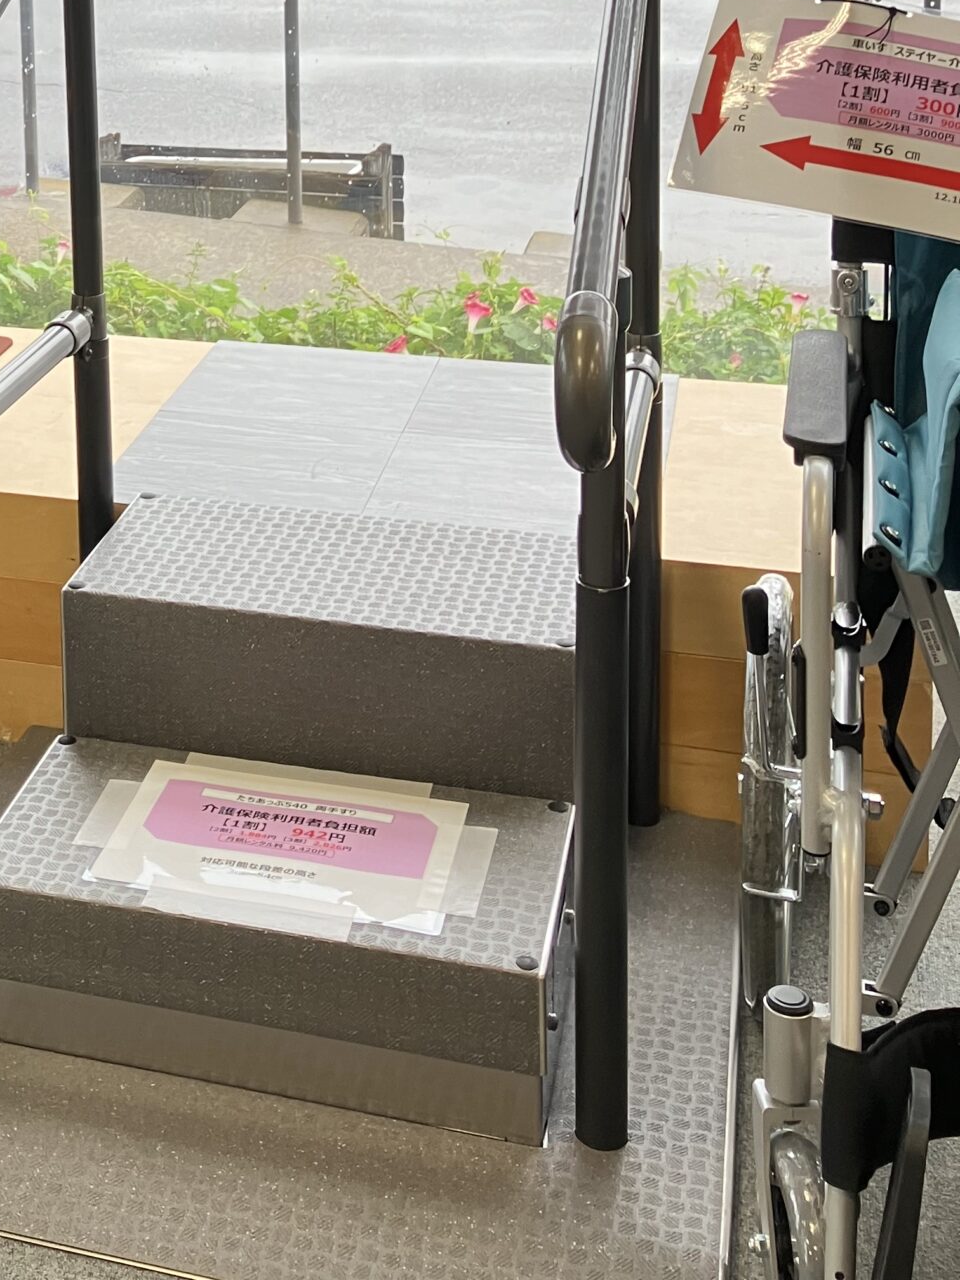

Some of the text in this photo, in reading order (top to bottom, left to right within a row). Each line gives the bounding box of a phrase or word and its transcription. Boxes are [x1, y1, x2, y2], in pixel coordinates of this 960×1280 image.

[852, 39, 888, 52] 車いす
[870, 106, 901, 118] 600円
[916, 97, 960, 118] 300
[848, 116, 955, 143] 月額レンタル料 3000円
[847, 137, 863, 151] 幅
[873, 142, 894, 156] 56
[935, 192, 960, 204] 12.1
[236, 795, 308, 810] たちあっぷ540
[201, 803, 378, 837] 介護保険利用者負担額
[291, 827, 346, 844] 942円
